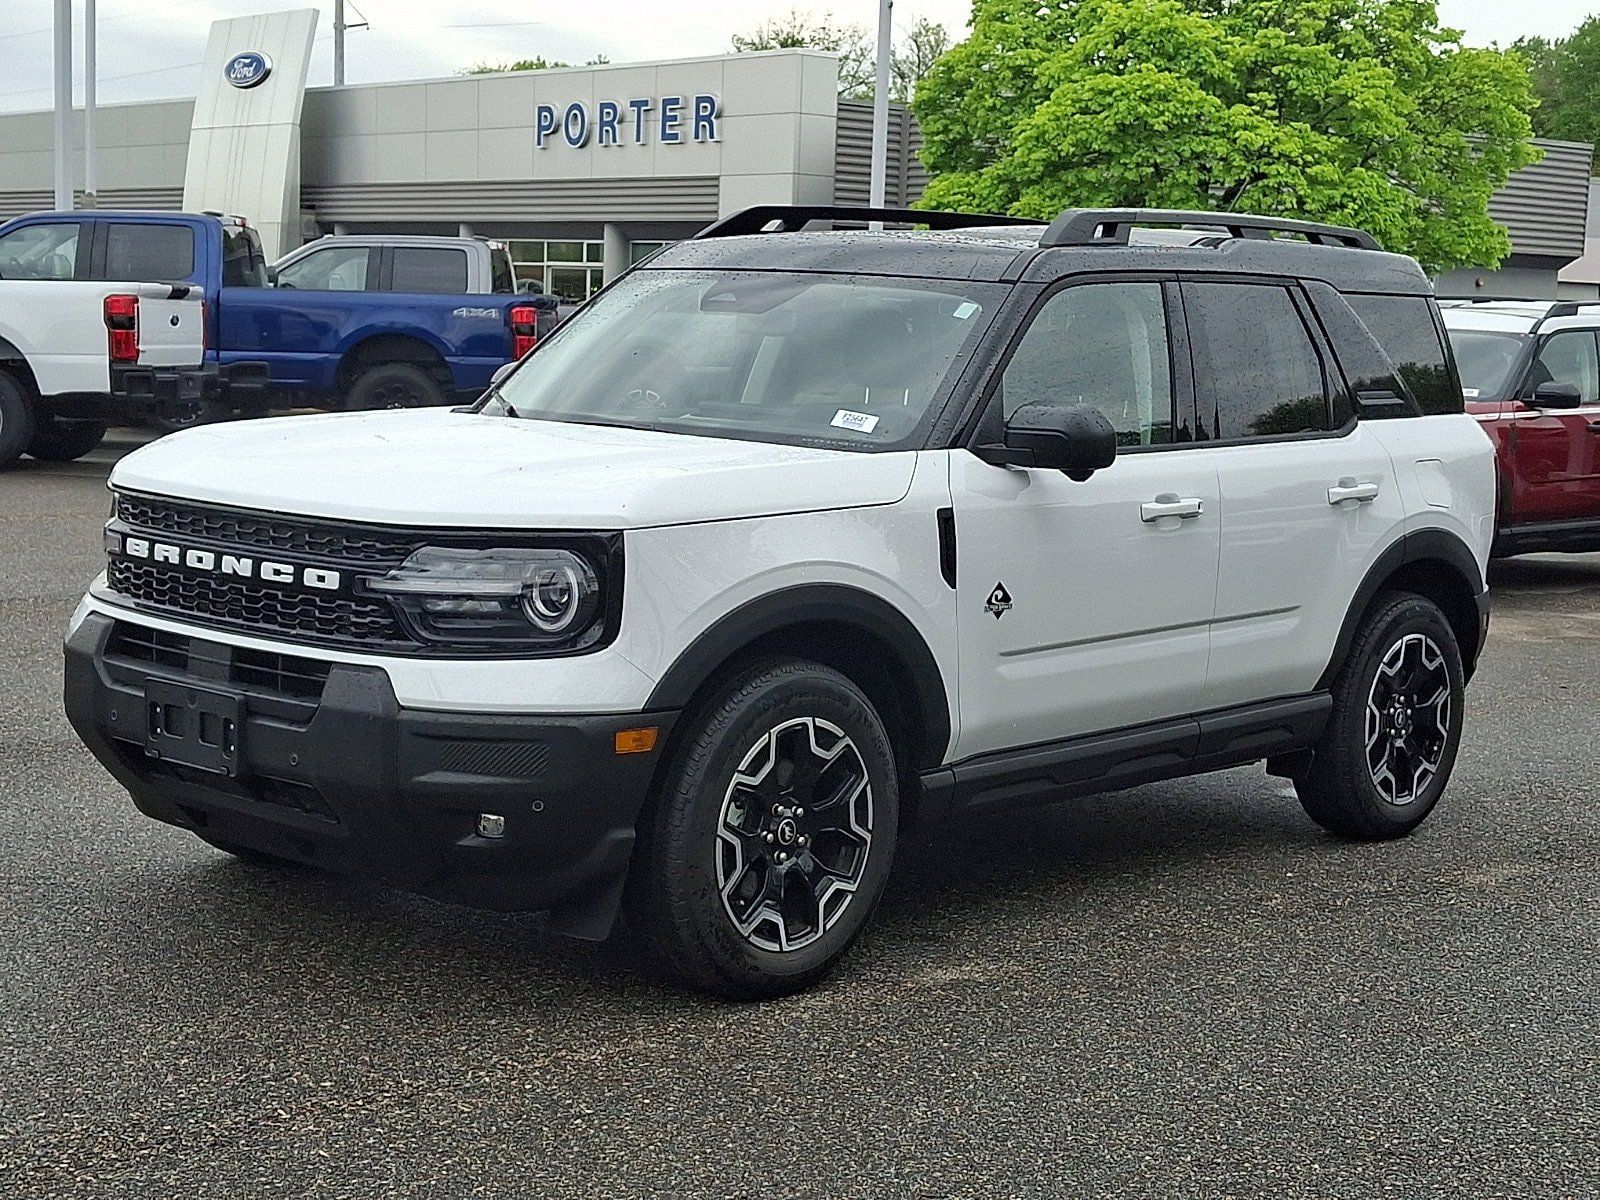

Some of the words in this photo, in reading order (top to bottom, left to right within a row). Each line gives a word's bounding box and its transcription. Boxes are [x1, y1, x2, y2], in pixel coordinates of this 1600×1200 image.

[230, 58, 257, 79] Ford
[536, 93, 721, 149] PORTER
[126, 537, 341, 590] BRONCO
